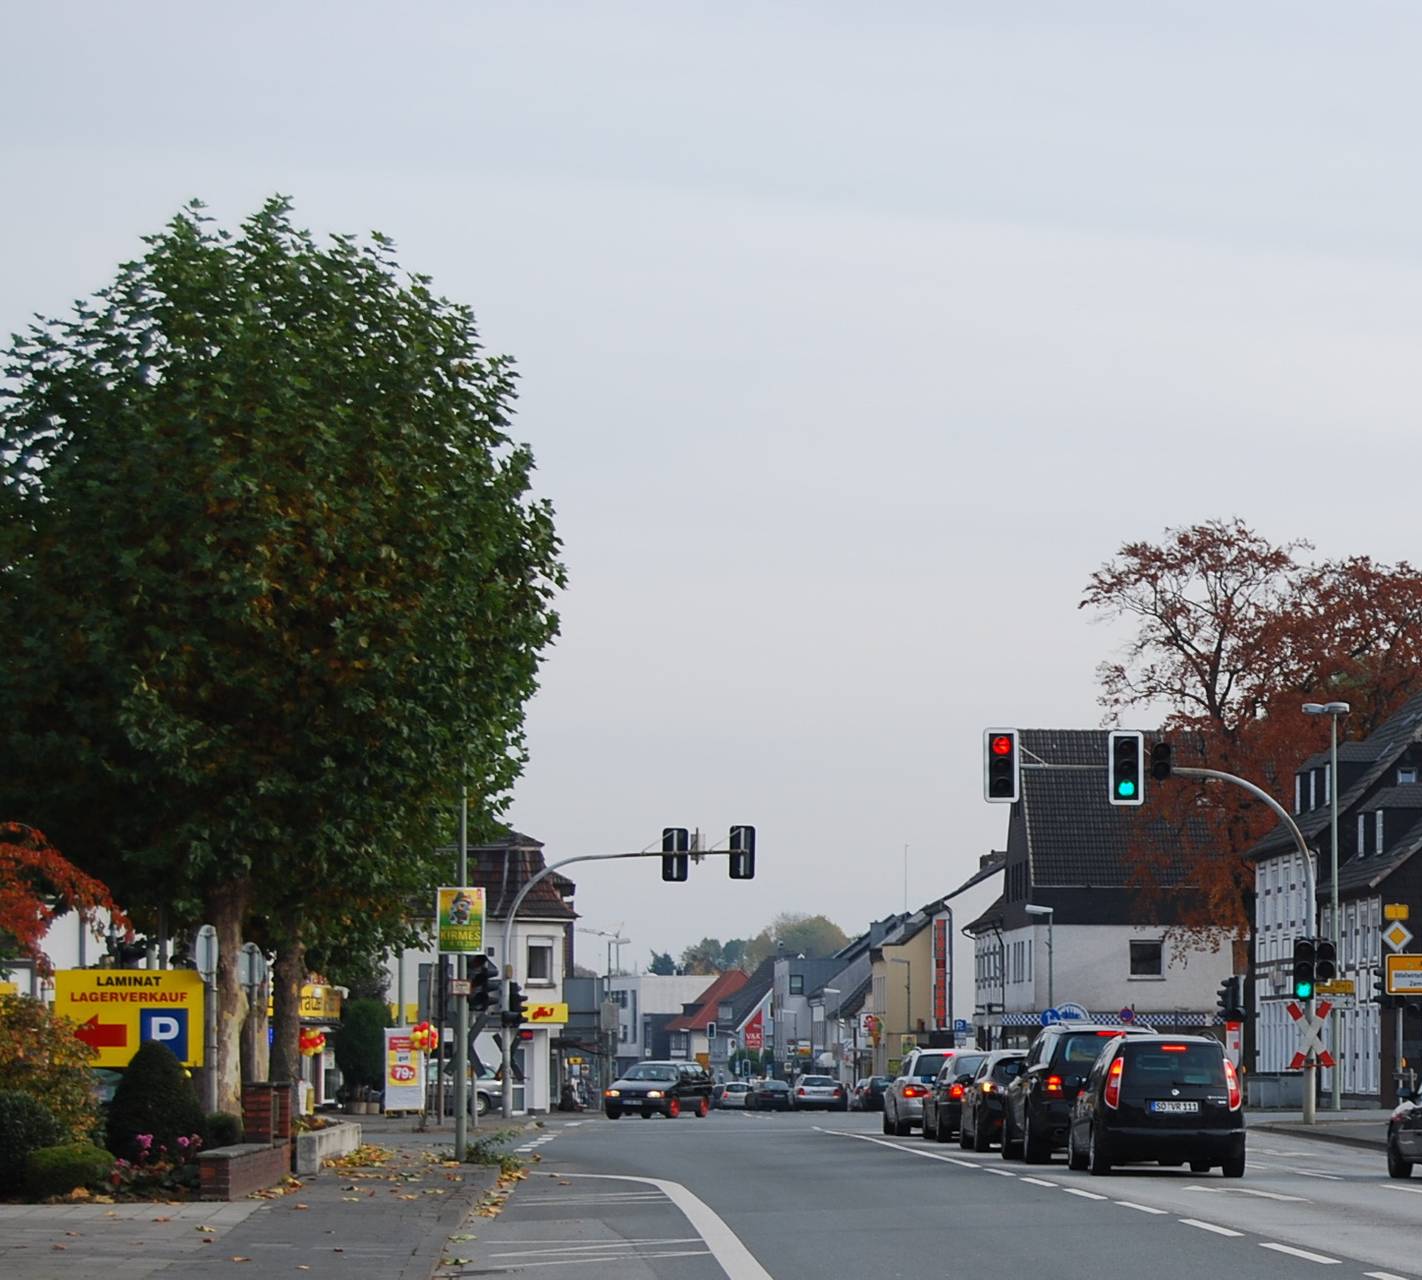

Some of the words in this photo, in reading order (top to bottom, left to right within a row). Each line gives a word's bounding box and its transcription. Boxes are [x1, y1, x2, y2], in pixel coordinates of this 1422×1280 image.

[440, 929, 481, 941] KIRMES
[96, 976, 162, 987] LAMINAT
[70, 991, 188, 1003] LAGERVERKAUF
